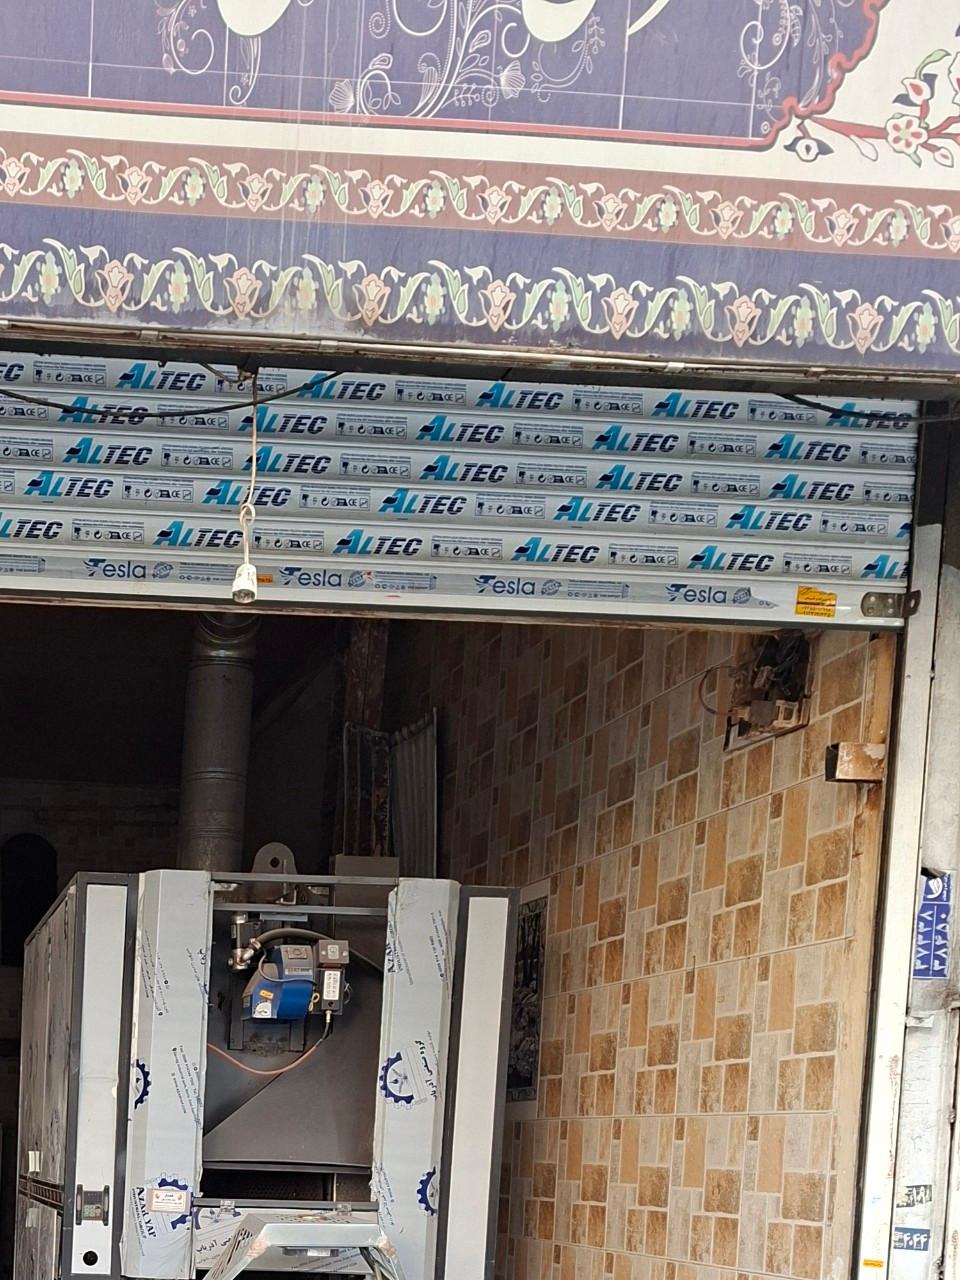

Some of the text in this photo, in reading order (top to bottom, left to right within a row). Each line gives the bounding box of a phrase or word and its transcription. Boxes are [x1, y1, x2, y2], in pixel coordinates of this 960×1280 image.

[115, 362, 205, 391] ALTEC
[298, 373, 386, 402] ALTEC
[57, 396, 147, 425] ALTEC
[475, 382, 562, 411] ALTEC
[652, 391, 737, 420] ALTEC
[242, 405, 331, 434] ALTEC
[414, 414, 501, 443] ALTEC
[828, 401, 912, 430] ALTEC
[60, 437, 150, 466] ALTEC
[589, 424, 675, 453] ALTEC
[764, 433, 848, 462] ALTEC
[240, 445, 329, 474] ALTEC
[418, 454, 505, 483] ALTEC
[22, 470, 112, 499] ALTEC
[594, 464, 680, 493] ALTEC
[768, 473, 852, 502] ALTEC
[200, 479, 289, 508] ALTEC
[375, 487, 463, 516] ALTEC
[551, 495, 637, 524] ALTEC
[723, 504, 808, 533] ALTEC
[154, 520, 243, 549] ALTEC
[332, 529, 420, 558] ALTEC
[511, 536, 597, 565] ALTEC
[686, 545, 771, 574] ALTEC
[82, 557, 147, 580] Tesla
[278, 566, 343, 588] Tesla
[474, 575, 538, 597] Tesla
[664, 582, 728, 605] Tesla
[145, 1218, 157, 1238] YAP
